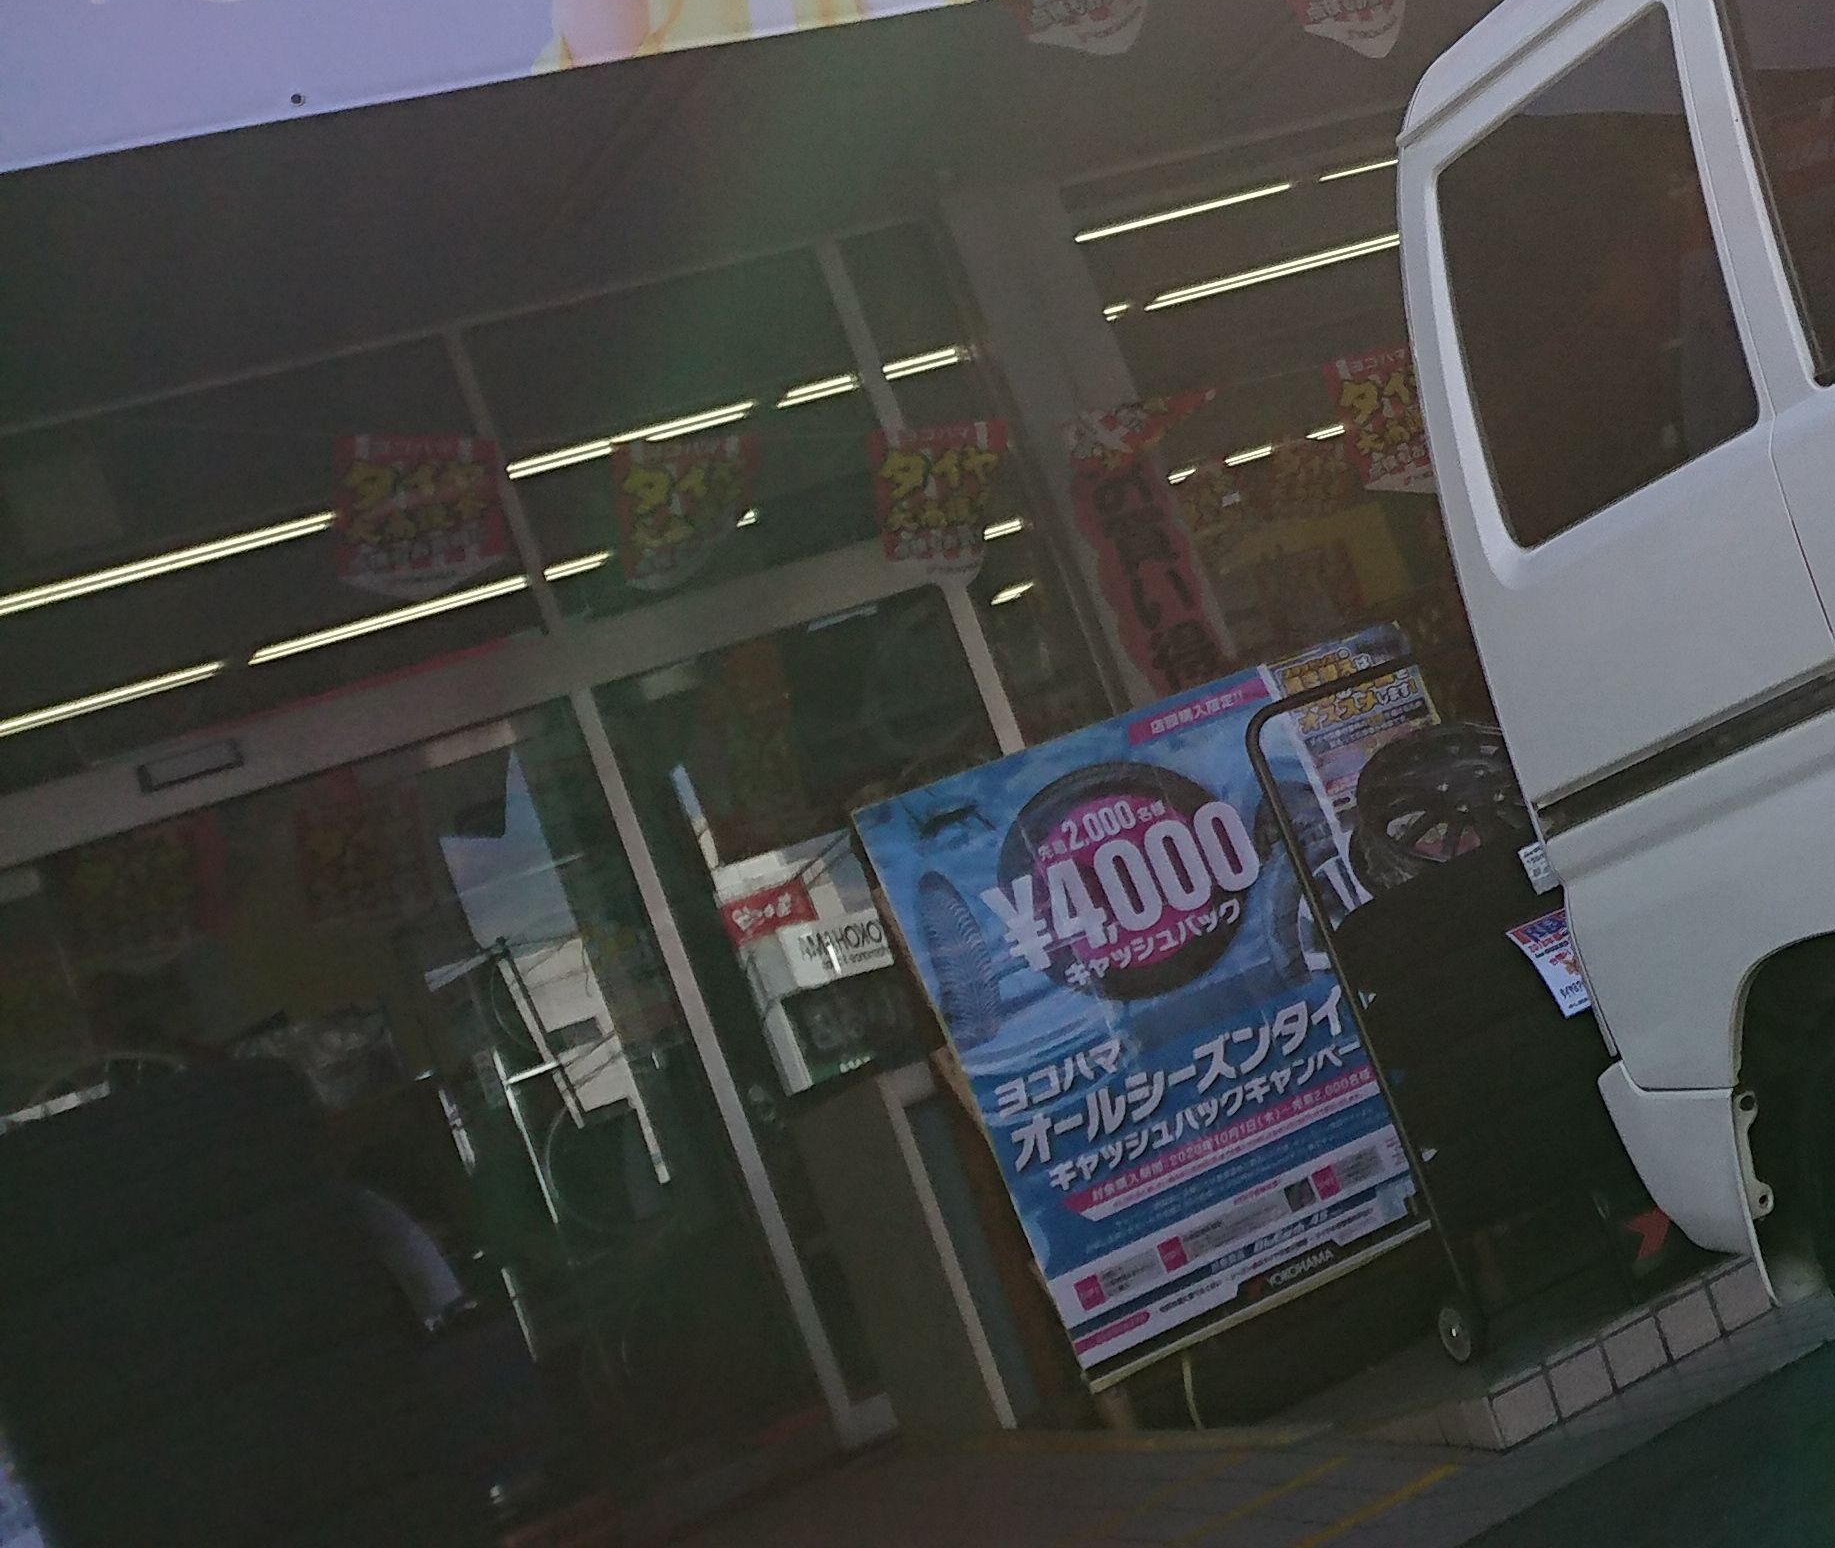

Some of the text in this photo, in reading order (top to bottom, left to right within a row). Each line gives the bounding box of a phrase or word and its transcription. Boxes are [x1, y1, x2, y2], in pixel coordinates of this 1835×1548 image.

[980, 800, 1262, 976] ¥4,000
[997, 1037, 1125, 1113] ヨコハマ
[1011, 984, 1346, 1172] オールシーズンタイ
[1049, 1040, 1361, 1193] キャッシュバックキャンペー
